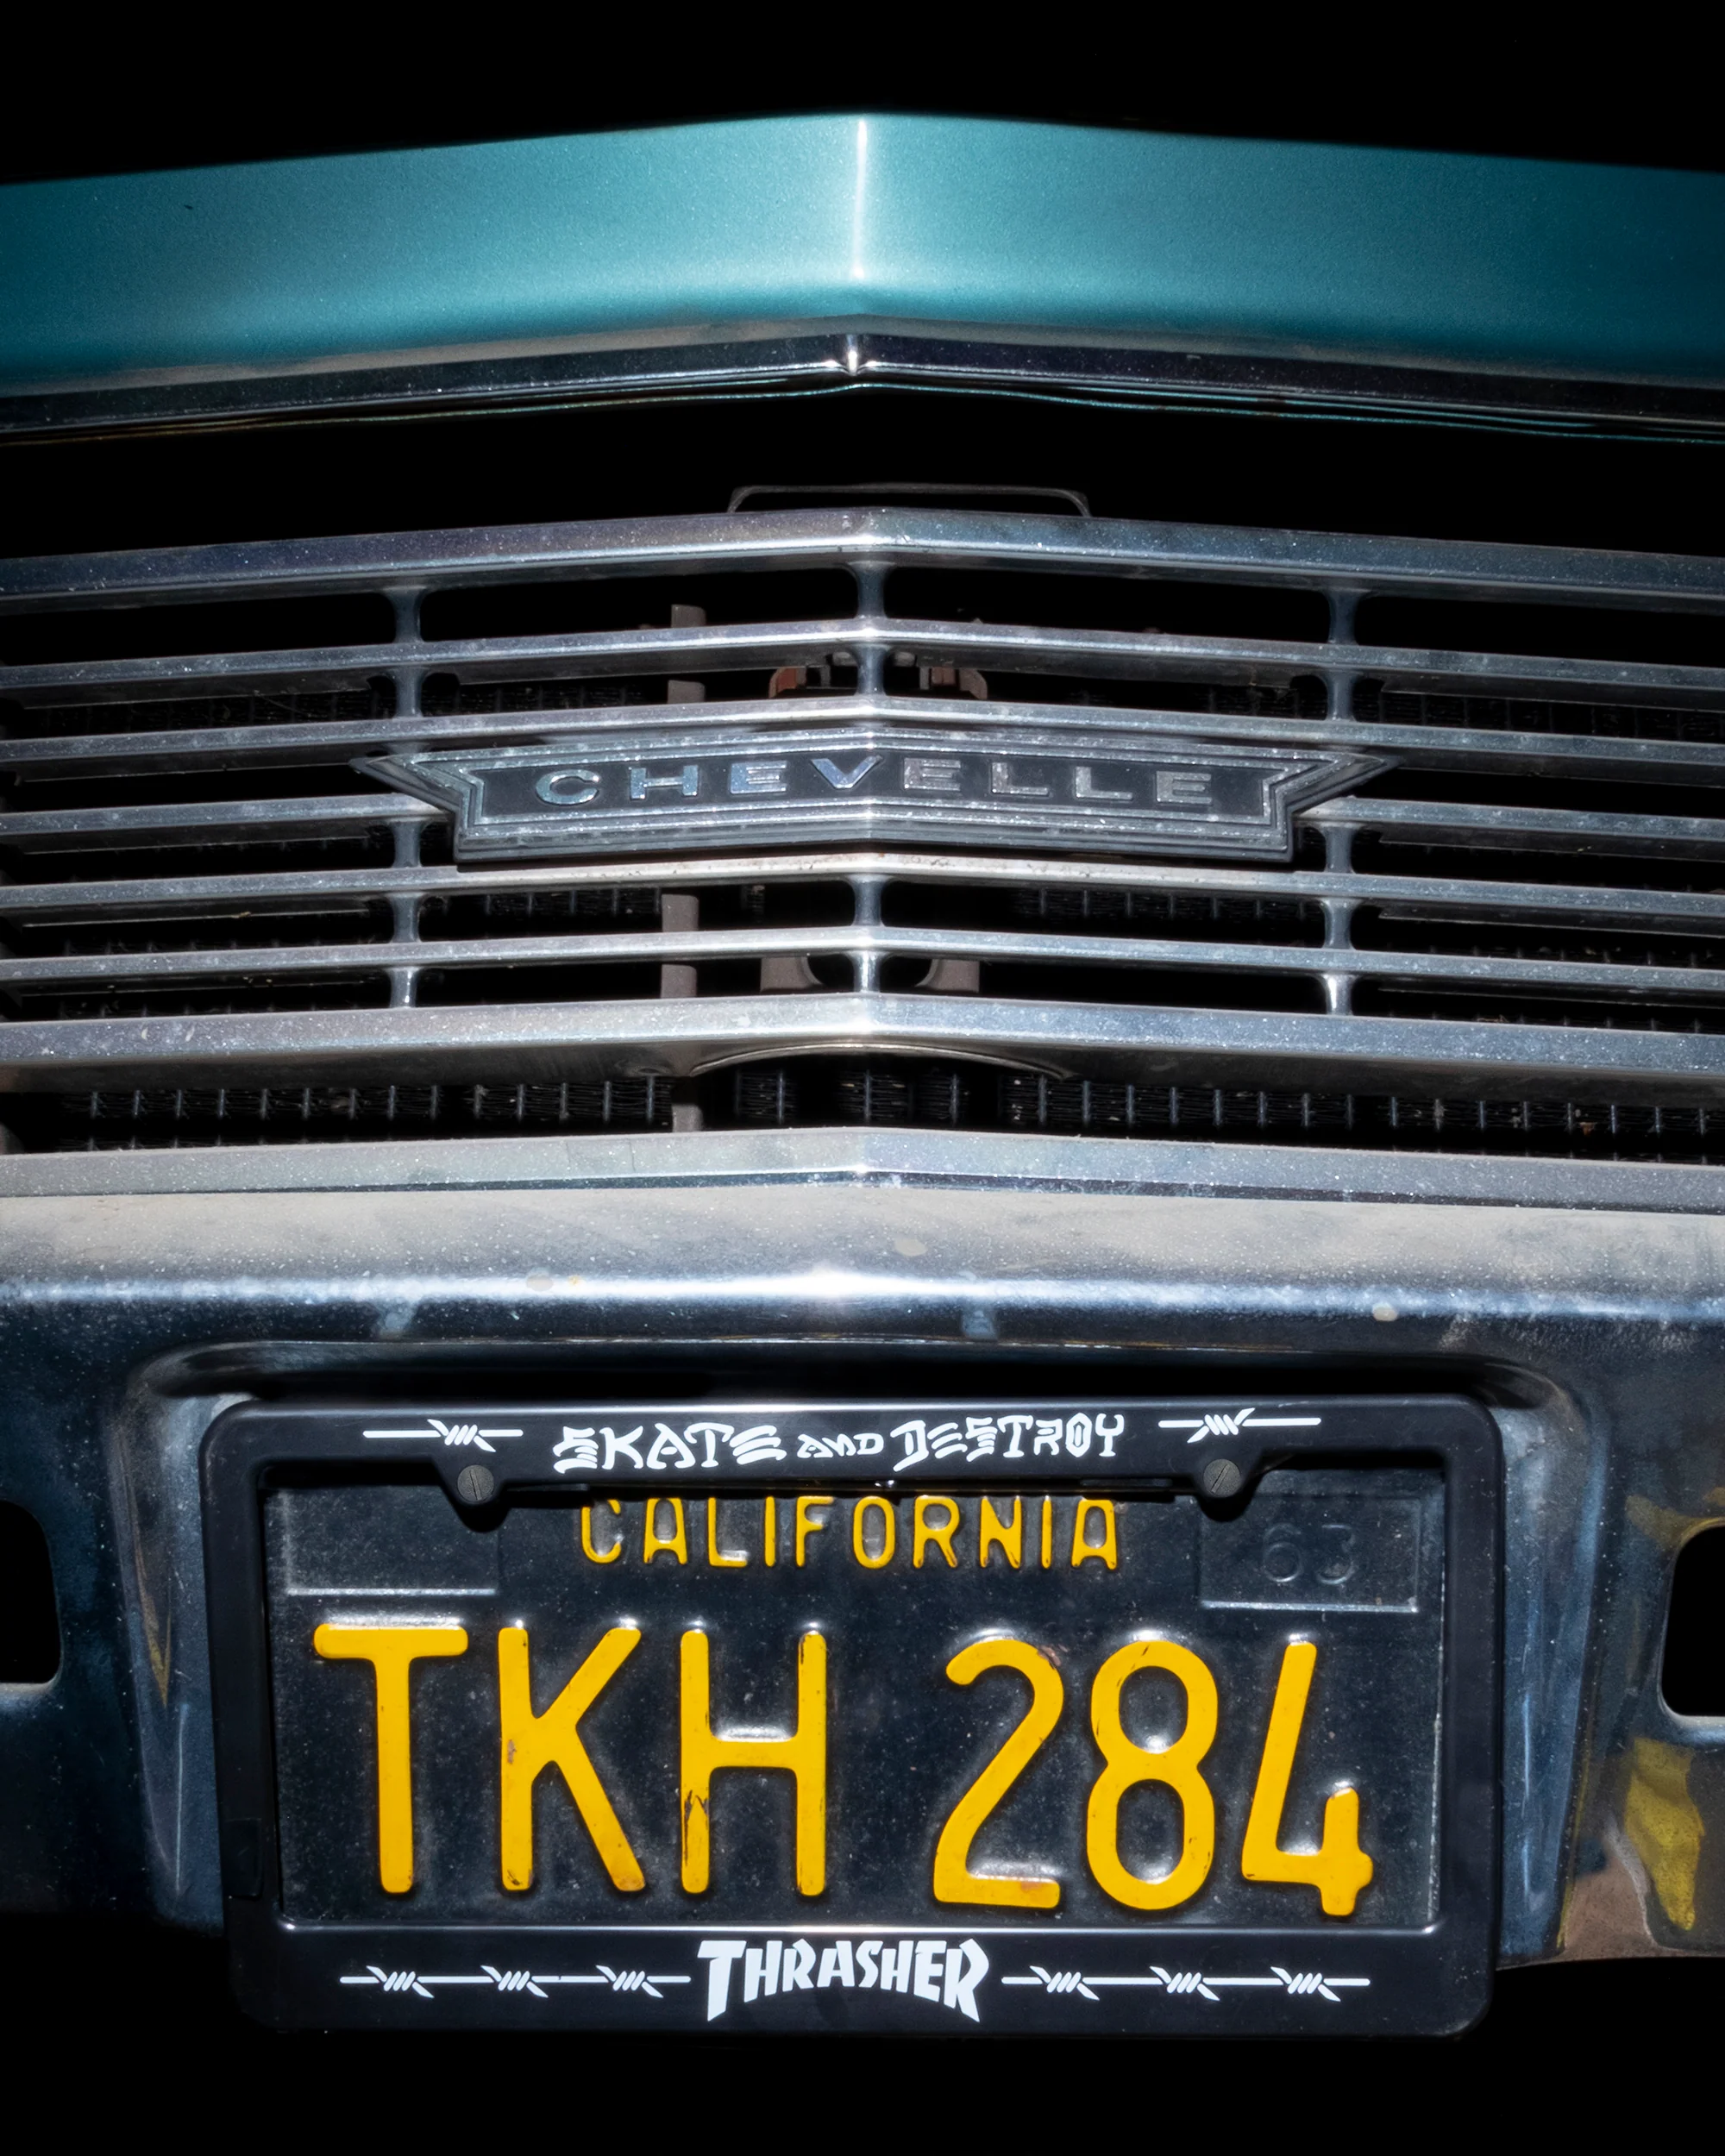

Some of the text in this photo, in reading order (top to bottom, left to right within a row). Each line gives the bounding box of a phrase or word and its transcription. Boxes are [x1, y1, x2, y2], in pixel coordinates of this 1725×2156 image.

[535, 756, 1214, 806] CHEVELLE
[552, 1412, 1125, 1474] SKATE AND DESTROY
[580, 1496, 1117, 1570] CALIFORNIA
[1264, 1522, 1354, 1583] 63
[314, 1623, 1373, 1915] TKH 284
[698, 1939, 991, 2022] THRASHER
